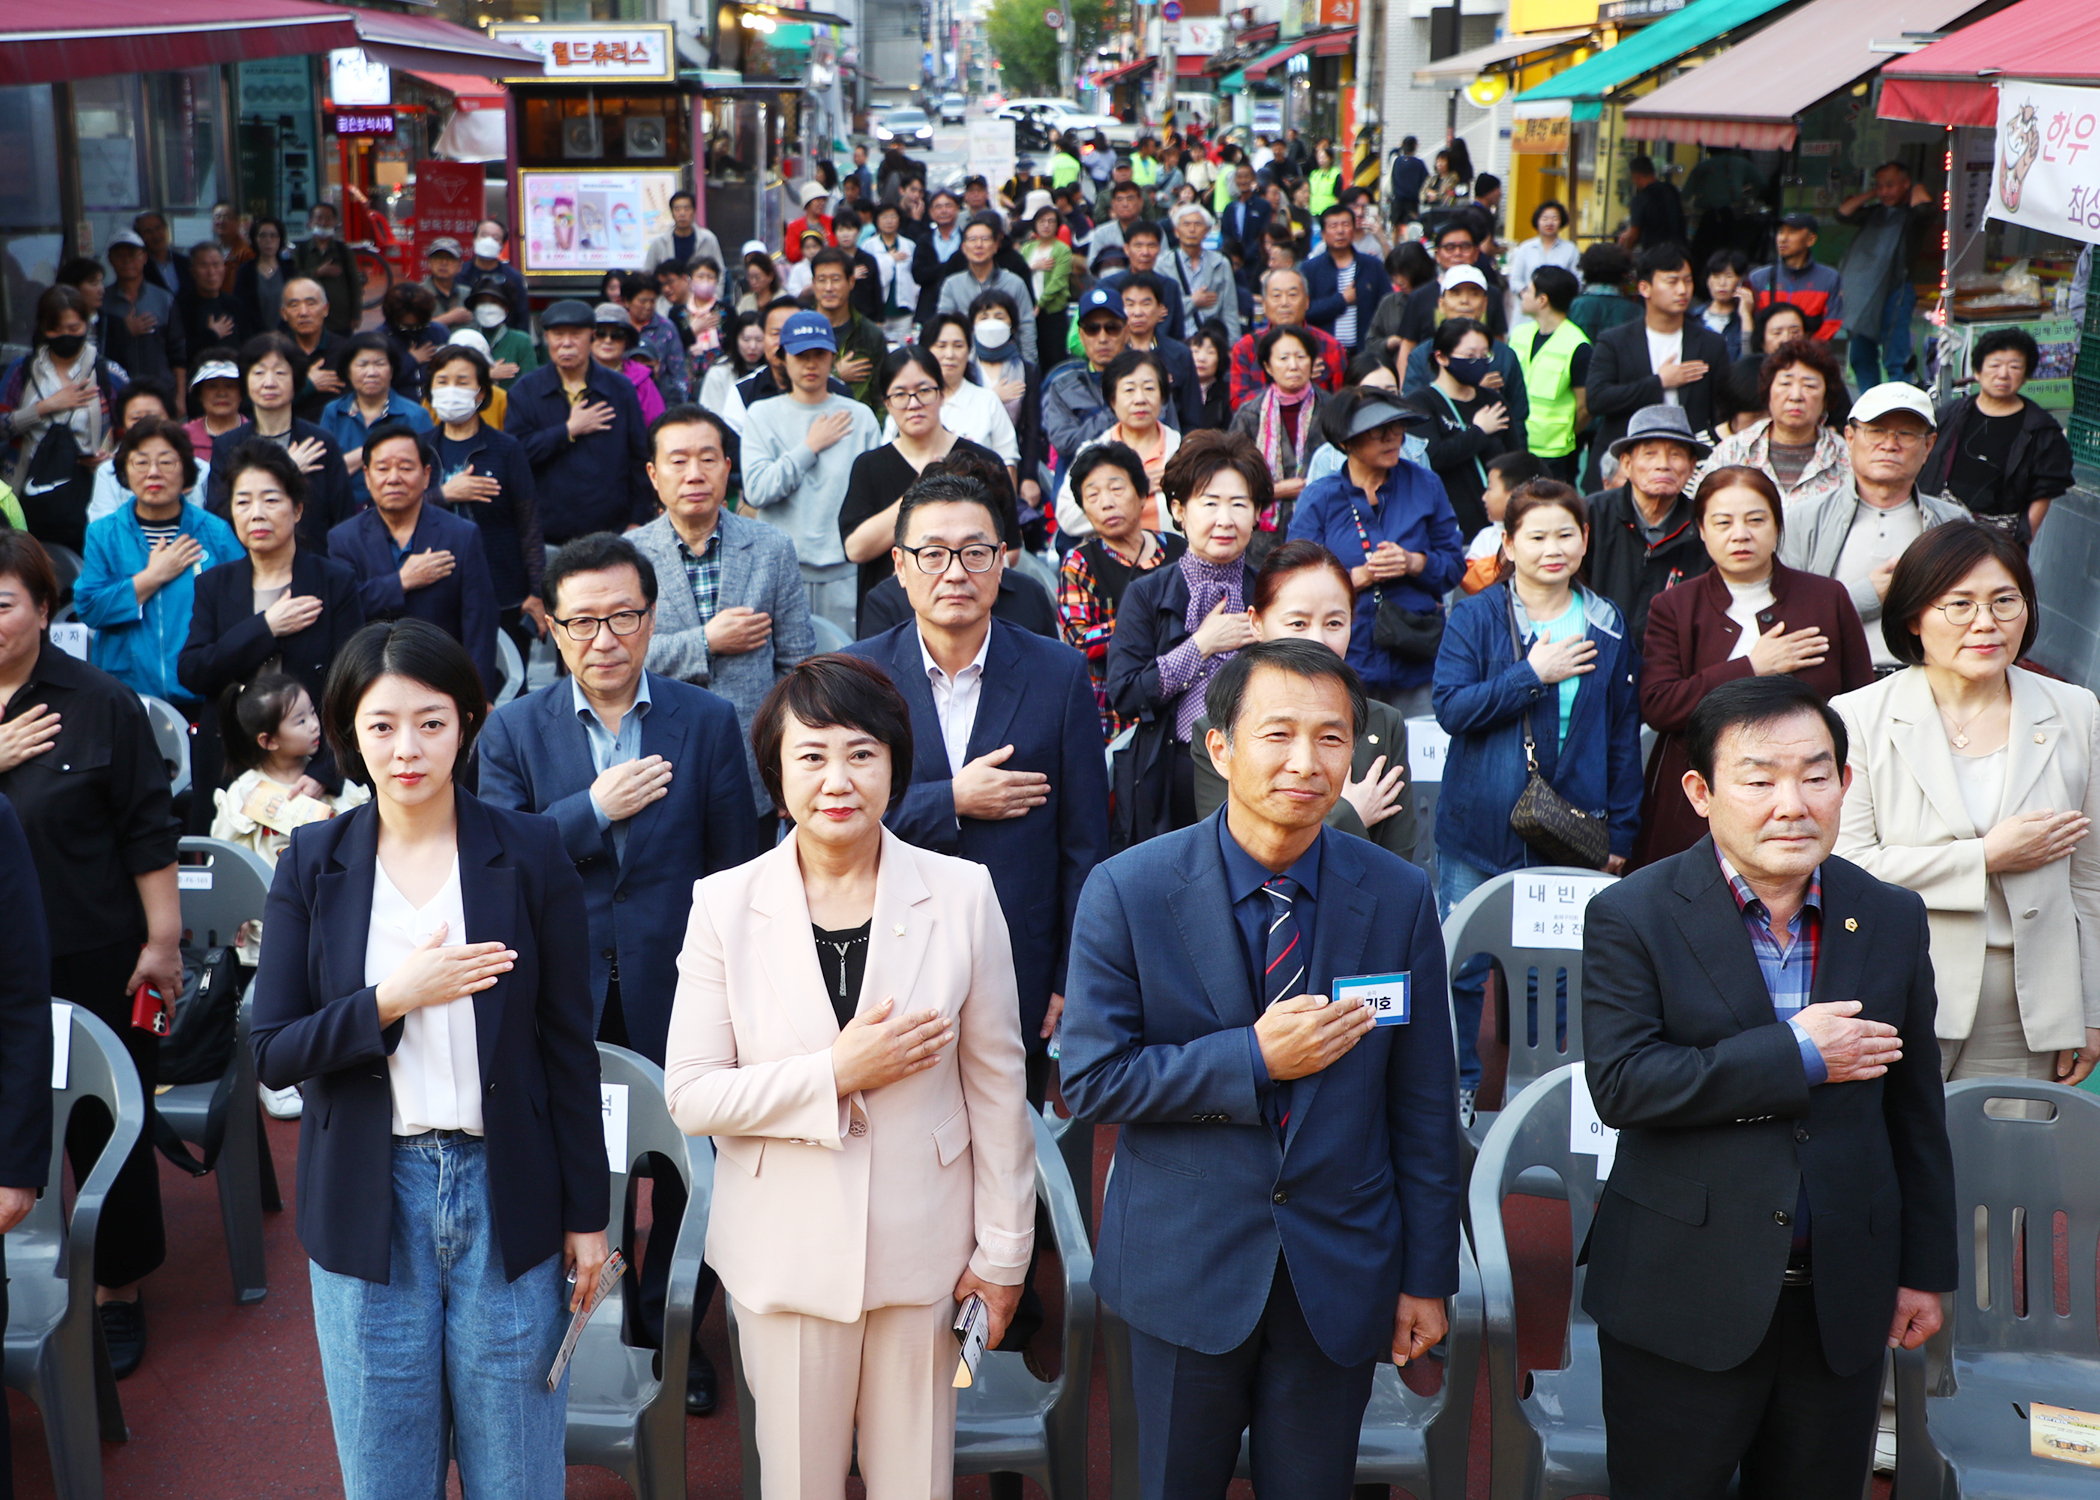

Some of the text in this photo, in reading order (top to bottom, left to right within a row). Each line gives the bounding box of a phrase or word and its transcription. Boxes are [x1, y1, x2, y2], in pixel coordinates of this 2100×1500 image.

[552, 40, 650, 66] 월드츄러스
[2043, 110, 2096, 166] 한우
[1361, 996, 1392, 1011] 기호
